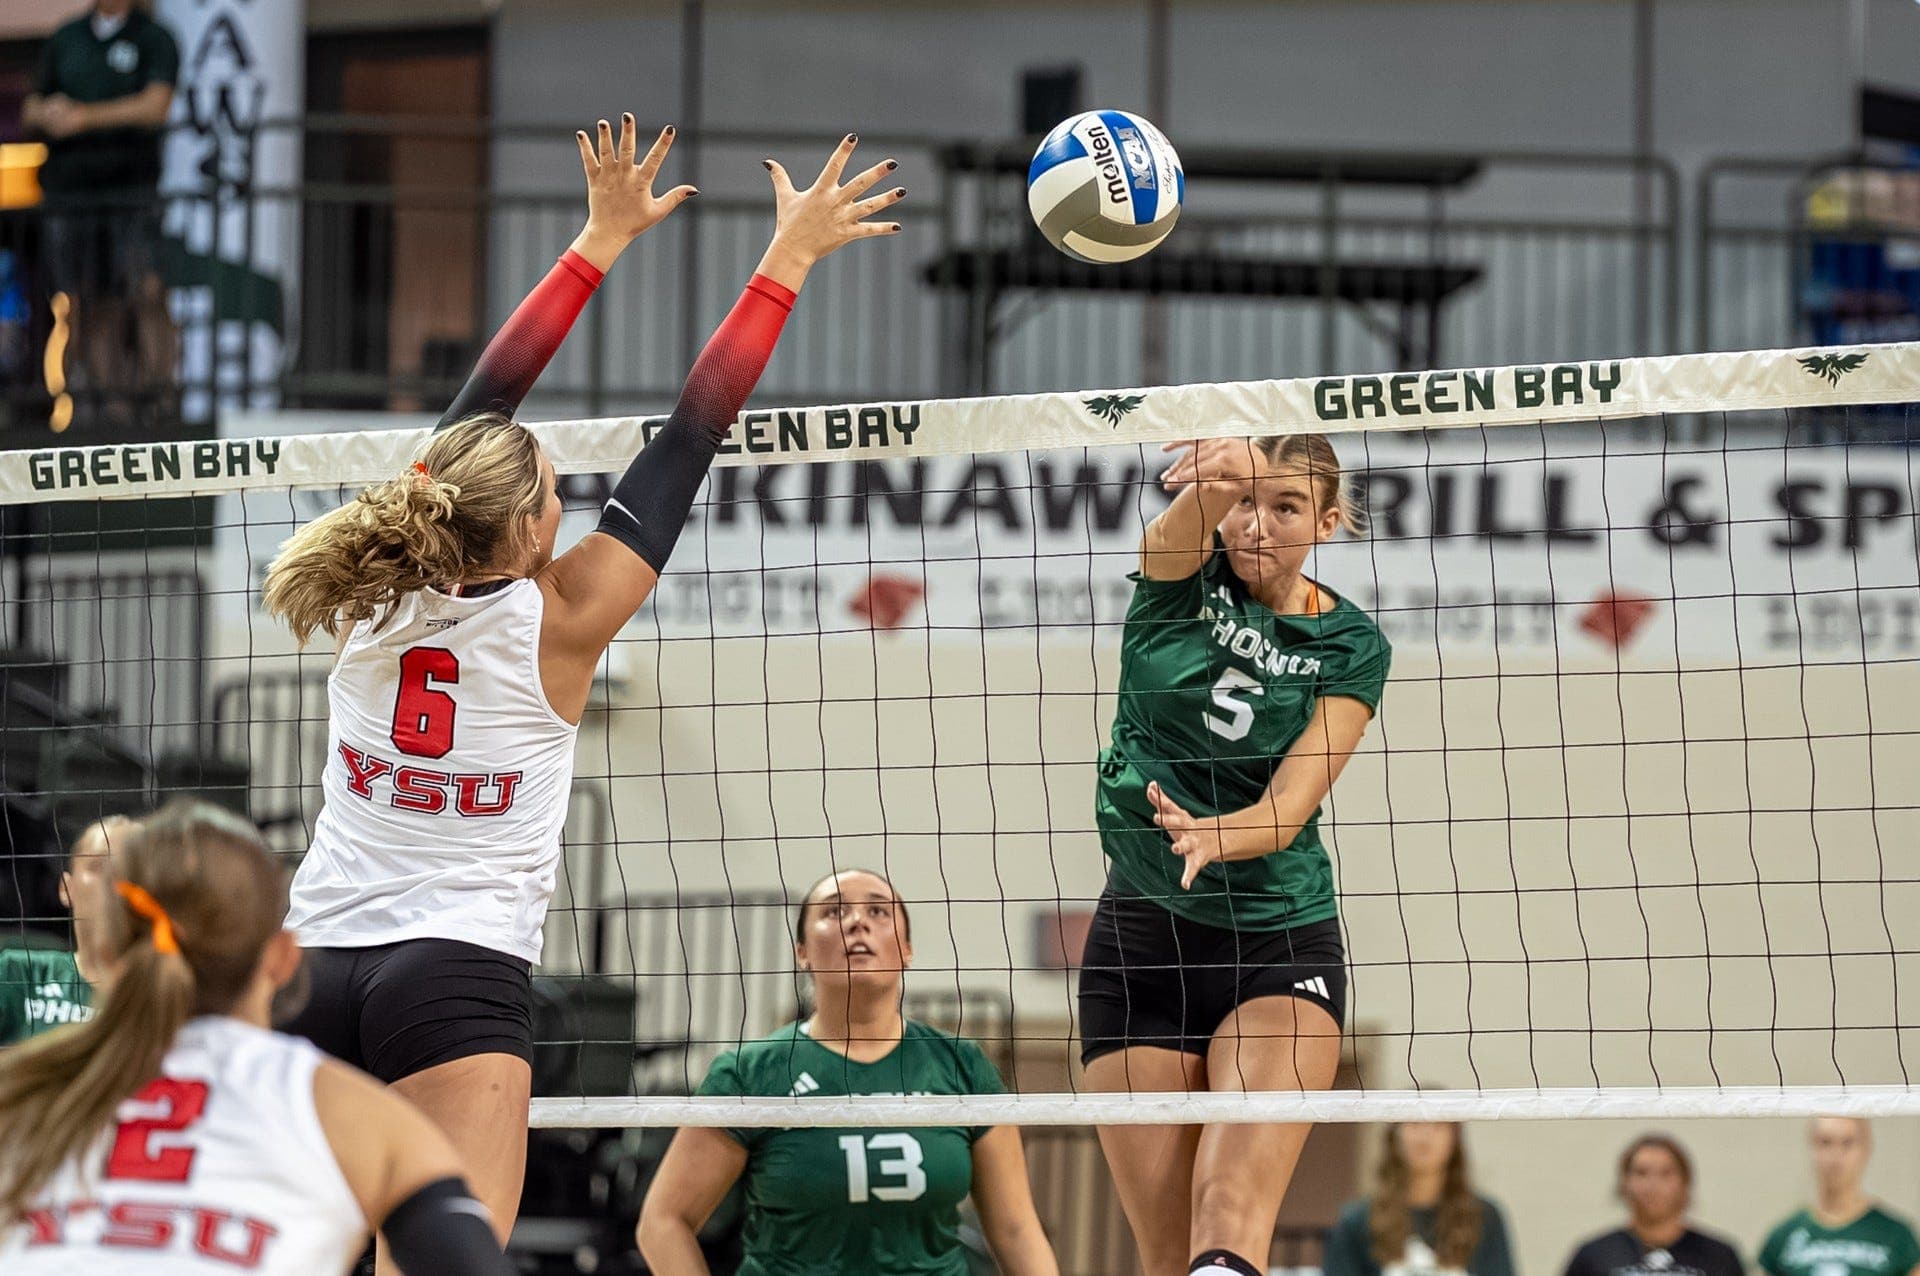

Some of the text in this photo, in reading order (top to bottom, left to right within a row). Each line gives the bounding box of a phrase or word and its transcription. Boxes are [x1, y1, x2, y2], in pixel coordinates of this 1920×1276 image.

[1086, 126, 1129, 205] molten
[1113, 126, 1156, 190] NCAA
[825, 404, 921, 449] BAY
[1314, 361, 1622, 420] GREEN BAY
[30, 439, 282, 490] GREEN BAY
[1352, 472, 1598, 544] RILL
[1649, 474, 1718, 548] &
[1771, 478, 1908, 552] SP
[390, 646, 459, 760] 6
[1202, 667, 1265, 742] 5
[338, 740, 523, 818] YSU
[104, 1077, 210, 1183] 2
[838, 1132, 927, 1203] 13
